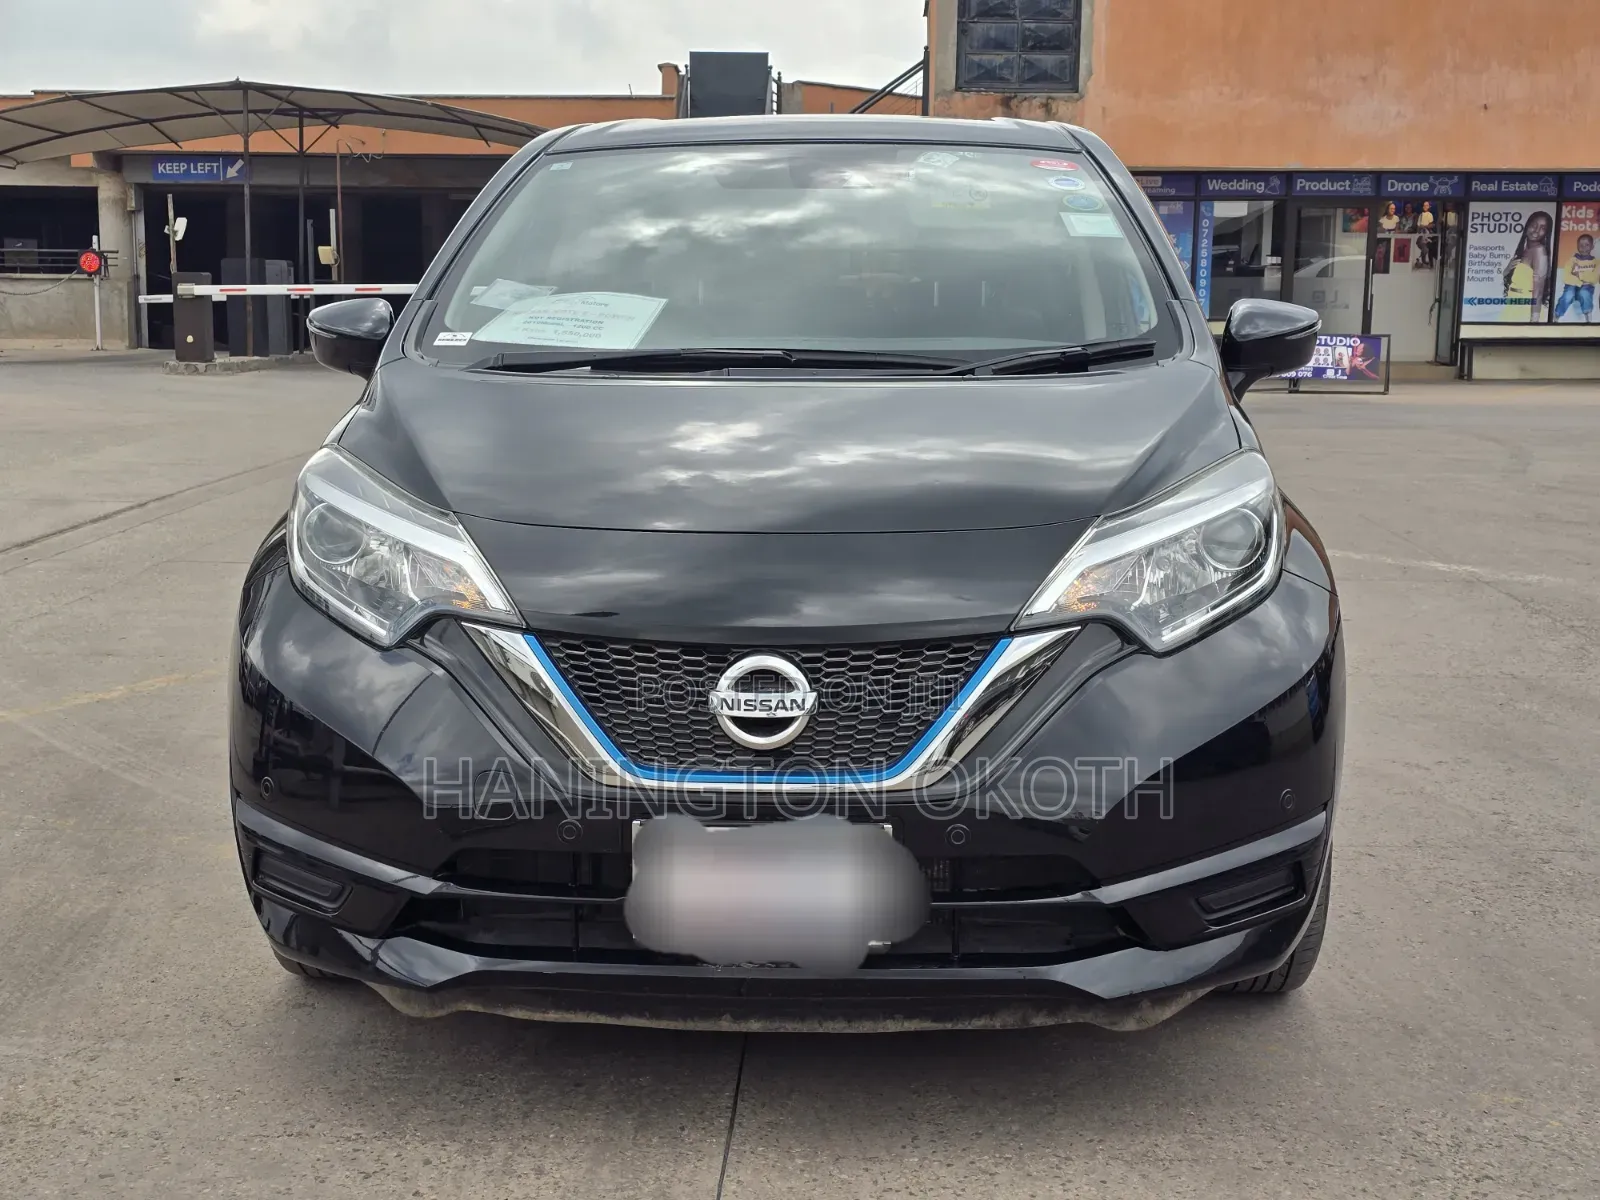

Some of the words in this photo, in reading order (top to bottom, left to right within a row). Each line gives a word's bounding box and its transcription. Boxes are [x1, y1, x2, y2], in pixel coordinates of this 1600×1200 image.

[158, 162, 187, 173] KEEP
[190, 162, 219, 173] LEFT
[1207, 179, 1266, 193] Wedding
[1296, 179, 1351, 191] Product
[1387, 180, 1430, 192] Drone
[1471, 181, 1498, 191] Real
[1501, 181, 1539, 191] Estate
[1143, 187, 1176, 195] reaming
[1471, 212, 1522, 222] PHOTO
[1561, 205, 1594, 218] Kids
[1469, 223, 1524, 233] STUDIO
[1560, 220, 1599, 231] Shots
[720, 697, 805, 711] NISSAN
